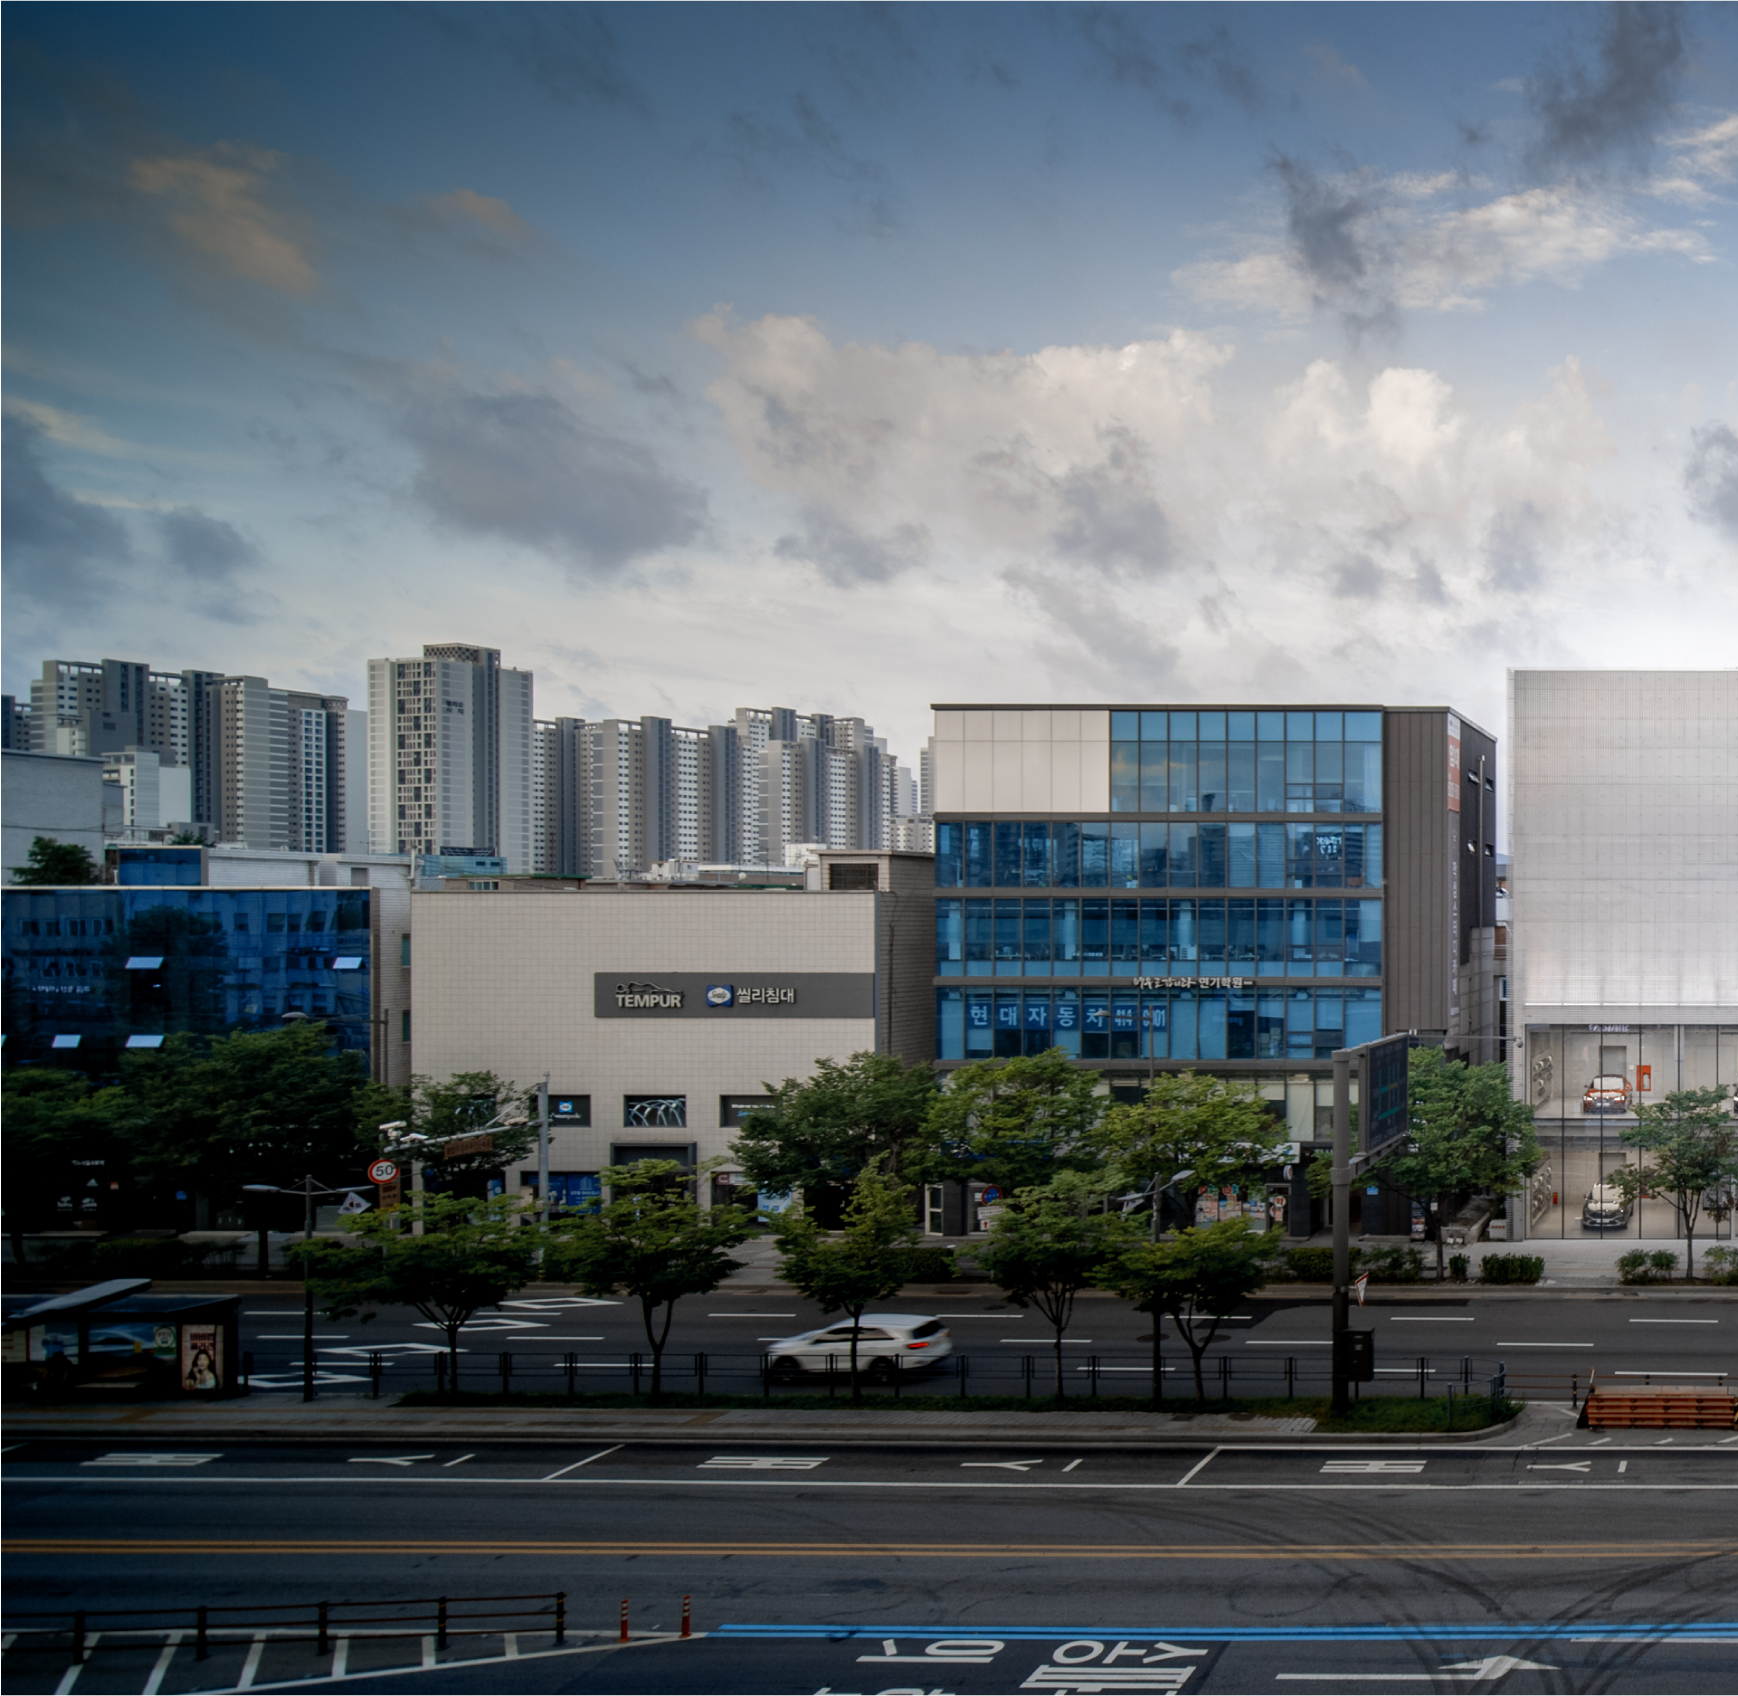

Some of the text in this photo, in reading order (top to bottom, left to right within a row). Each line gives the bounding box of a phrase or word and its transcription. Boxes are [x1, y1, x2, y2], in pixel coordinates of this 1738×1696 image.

[1198, 976, 1243, 989] 연기학원
[616, 994, 684, 1009] TEMPUR
[736, 987, 795, 1004] 씰리침대
[970, 1004, 1106, 1028] 현대자동차
[375, 1164, 395, 1177] 50
